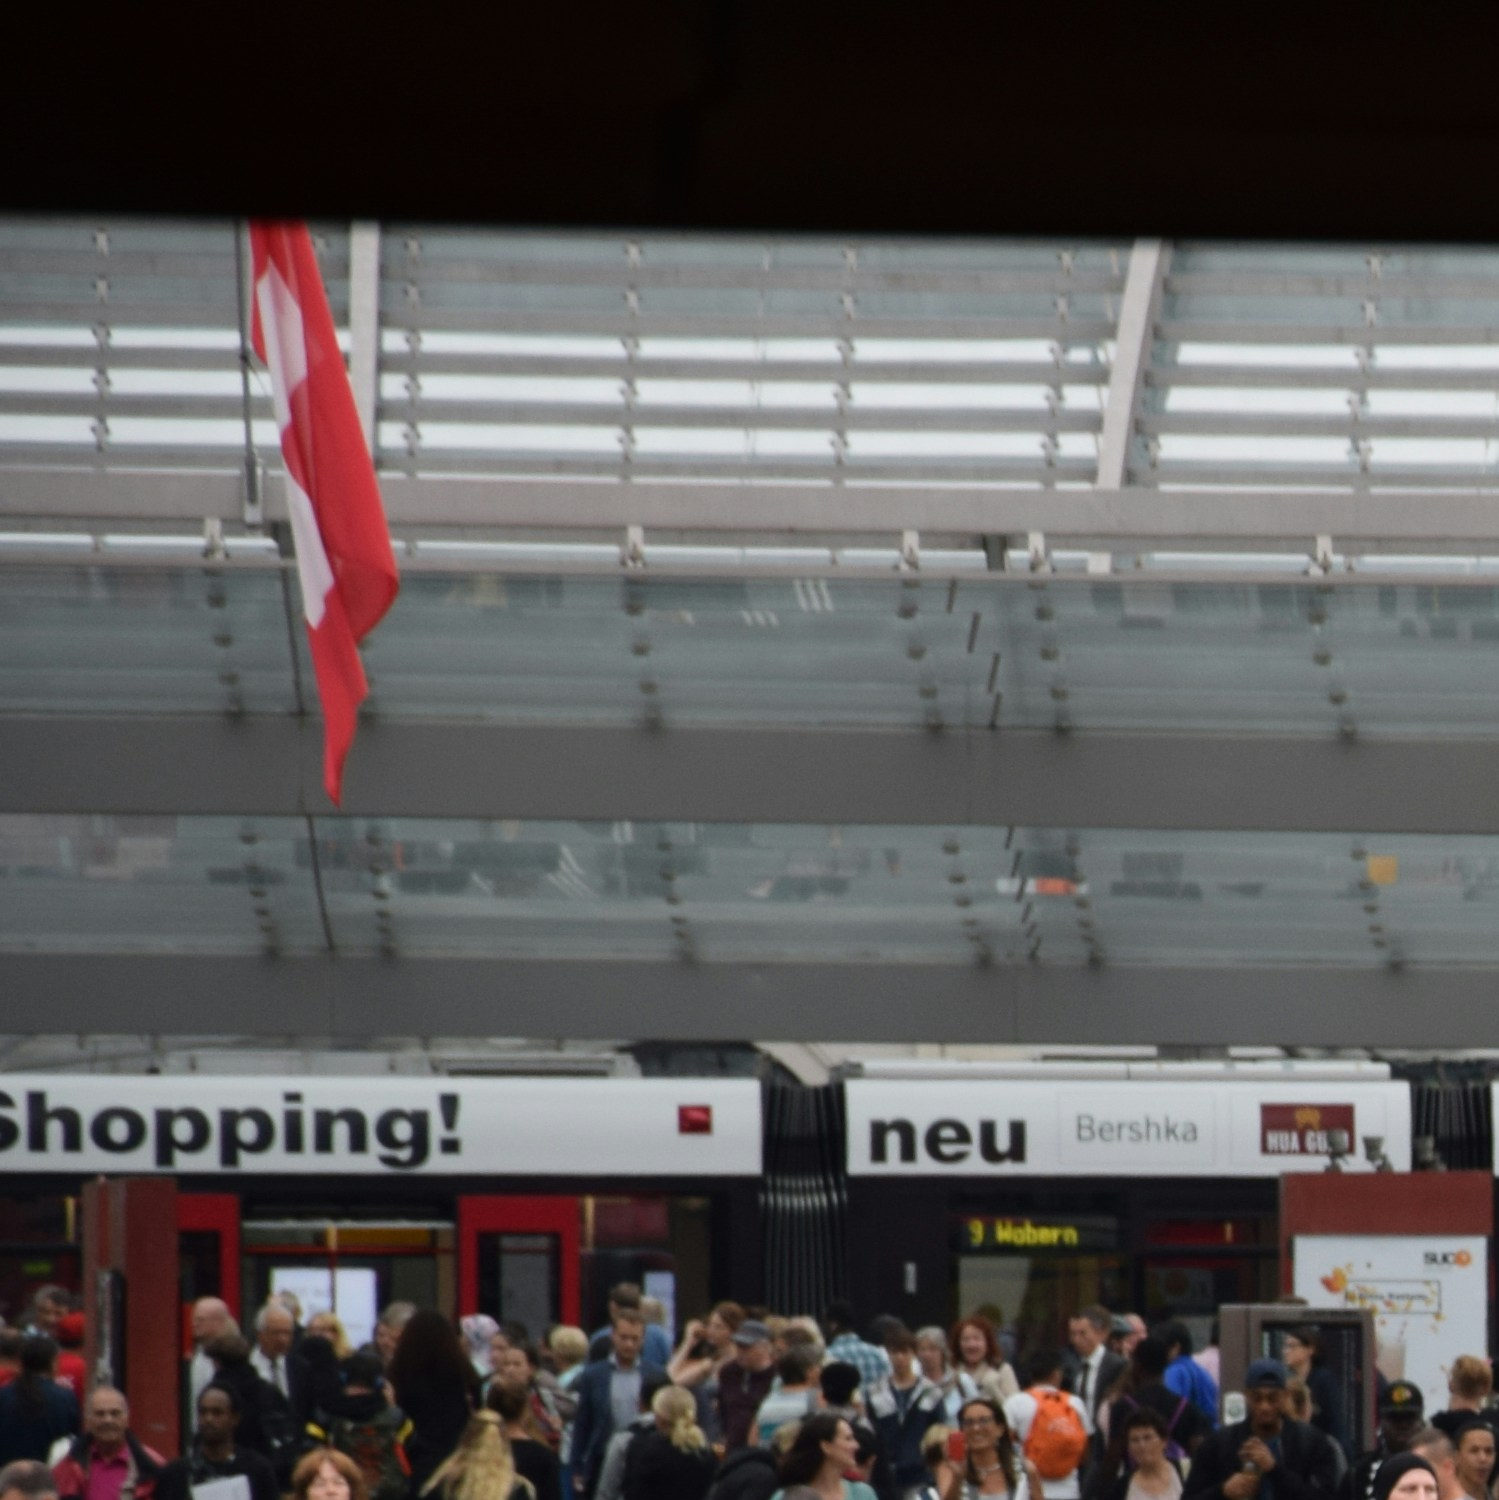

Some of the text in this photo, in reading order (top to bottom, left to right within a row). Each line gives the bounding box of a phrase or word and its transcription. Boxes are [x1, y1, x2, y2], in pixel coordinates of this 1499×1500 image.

[869, 1118, 1027, 1164] neu
[1076, 1114, 1199, 1143] Bershka
[1266, 1130, 1300, 1153] HUA
